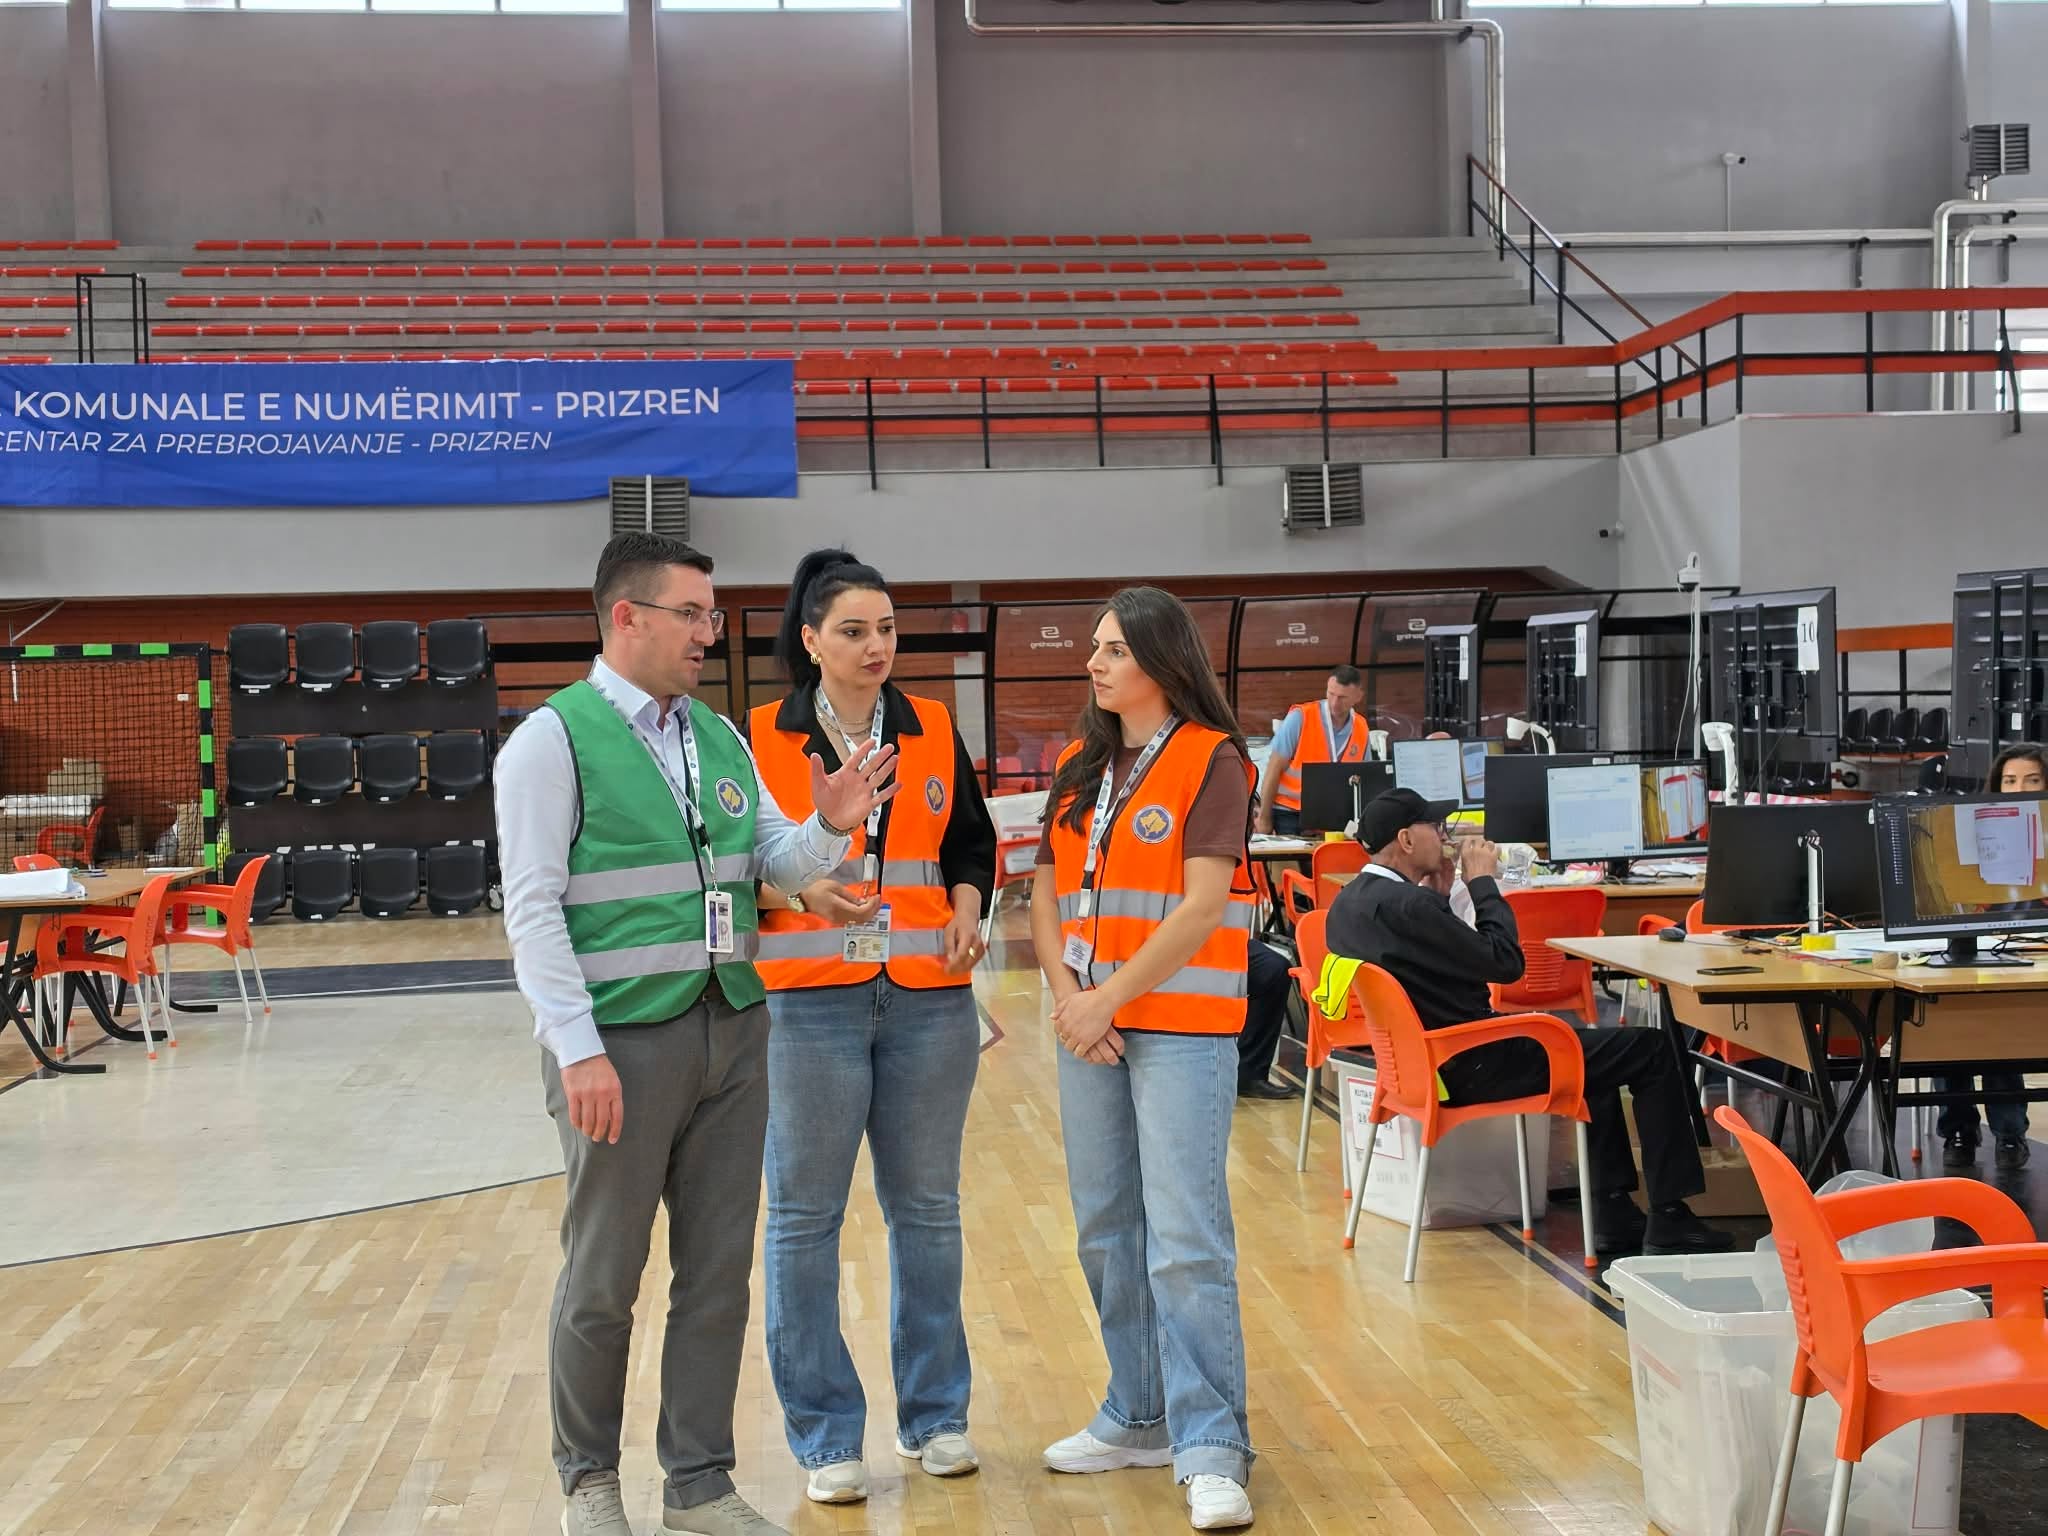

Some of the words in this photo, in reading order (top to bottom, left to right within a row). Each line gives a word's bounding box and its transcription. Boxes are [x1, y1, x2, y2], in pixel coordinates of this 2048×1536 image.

[15, 390, 245, 421] KOMUNALE
[260, 392, 281, 421] E
[295, 386, 520, 421] NUMËRIMIT
[557, 387, 719, 419] PRIZREN
[107, 432, 147, 453] ZA
[156, 433, 404, 454] PREBROJAVANJE
[429, 431, 552, 453] PRIZREN
[1802, 622, 1815, 643] 10
